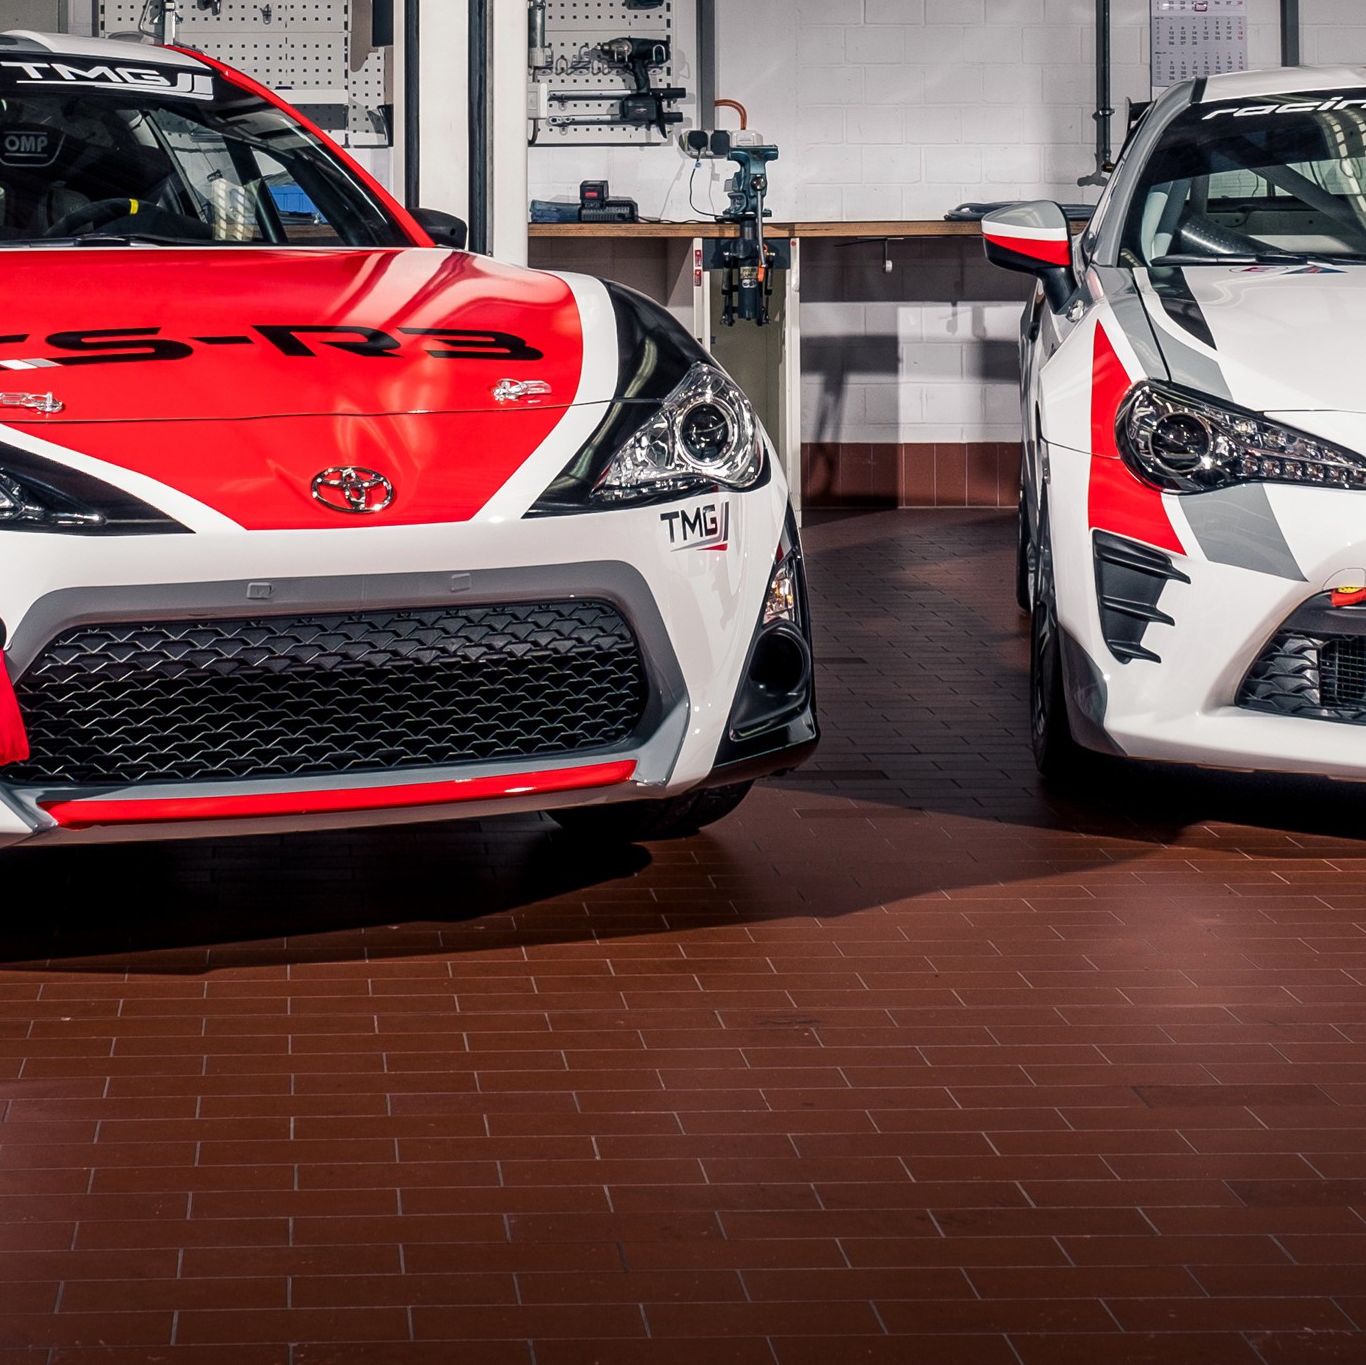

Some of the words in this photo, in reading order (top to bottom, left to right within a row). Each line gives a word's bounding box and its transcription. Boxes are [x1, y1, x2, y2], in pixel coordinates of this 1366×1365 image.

[0, 61, 169, 87] TMG
[4, 133, 48, 153] OMP
[659, 506, 719, 541] TMG
